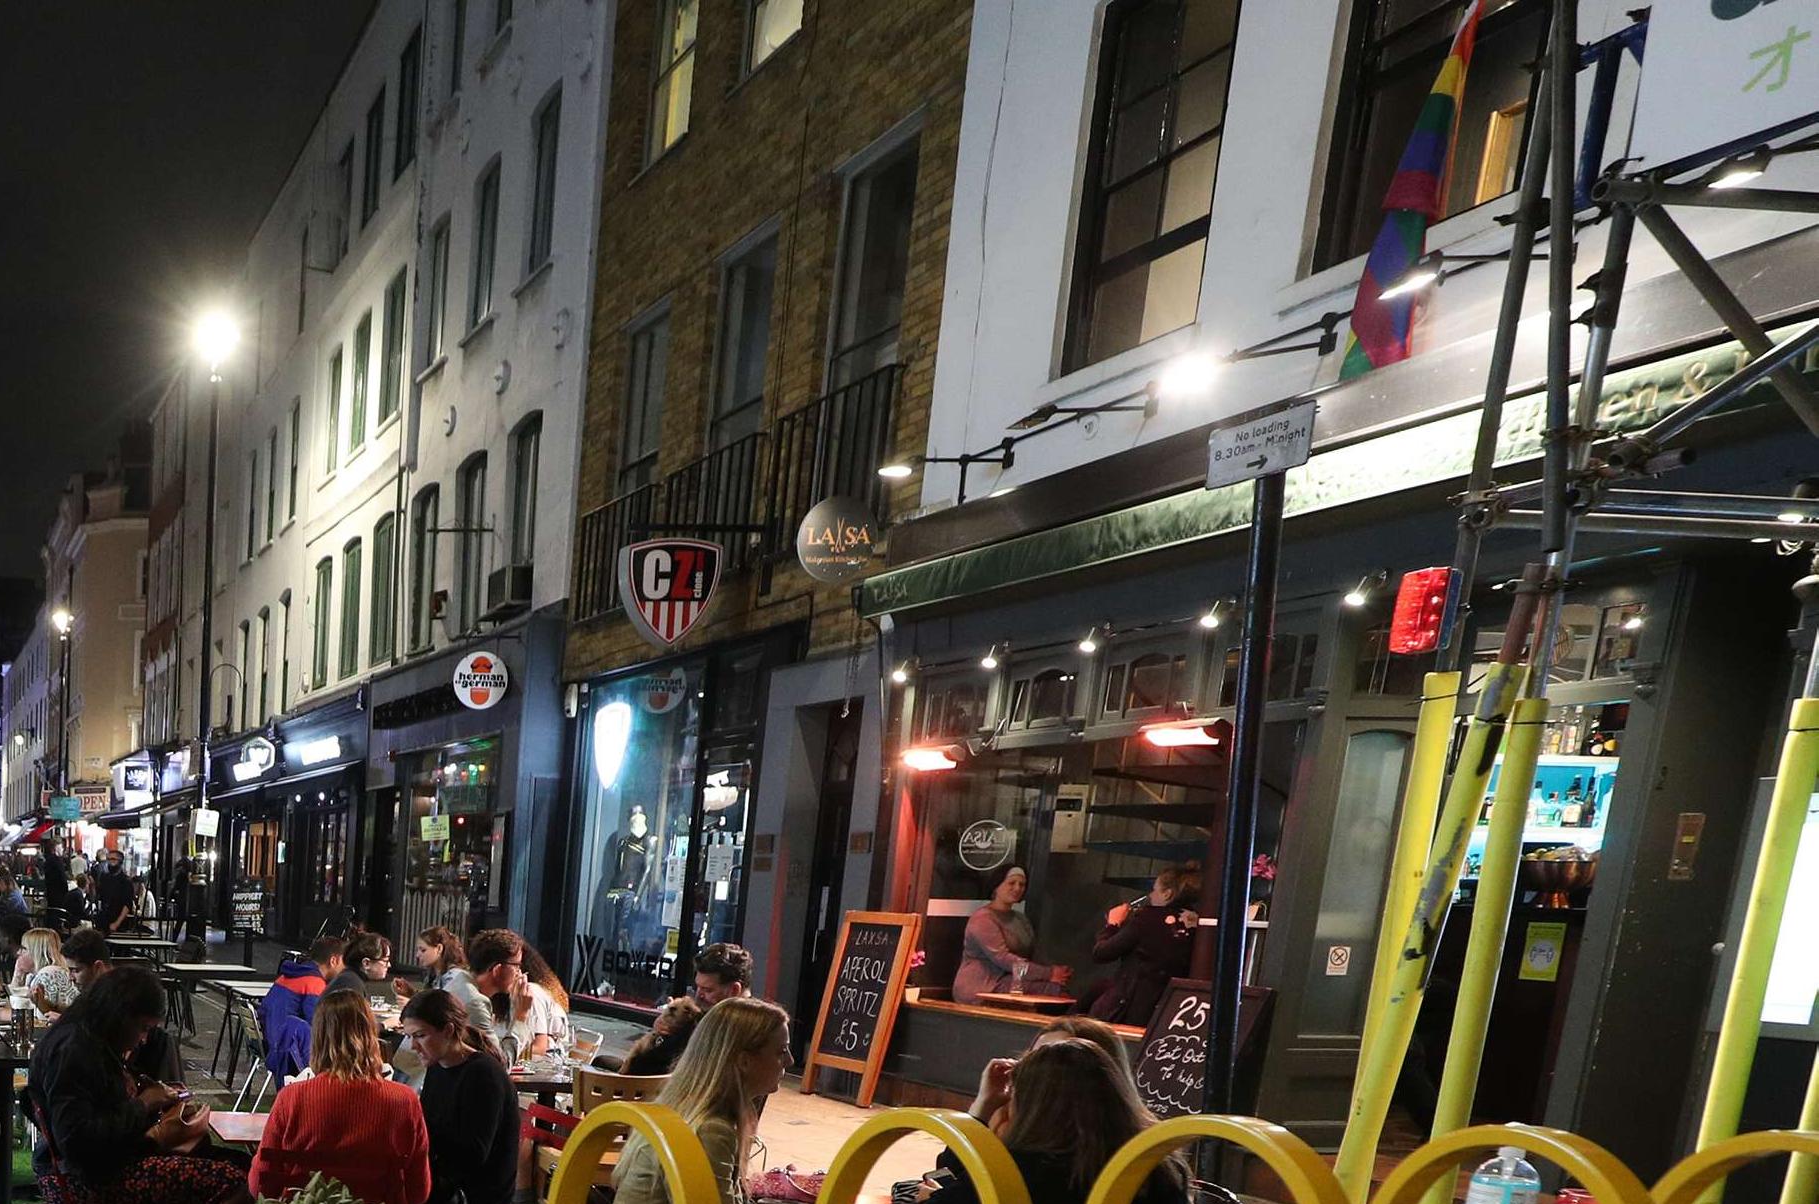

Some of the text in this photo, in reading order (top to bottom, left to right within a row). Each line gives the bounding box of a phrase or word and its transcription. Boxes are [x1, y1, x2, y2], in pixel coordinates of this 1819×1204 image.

[1235, 420, 1289, 443] No loading
[1214, 443, 1255, 461] 8.30am
[694, 570, 704, 599] clone
[458, 672, 504, 682] herman
[462, 680, 506, 688] german
[81, 795, 106, 810] PEN
[855, 928, 889, 946] LAXSA
[840, 956, 887, 984] APEROL
[833, 985, 879, 1018] SPRITZ
[1168, 996, 1211, 1031] 25
[834, 1019, 859, 1051] £5
[1154, 1042, 1206, 1063] Eat Out
[1160, 1064, 1175, 1080] To
